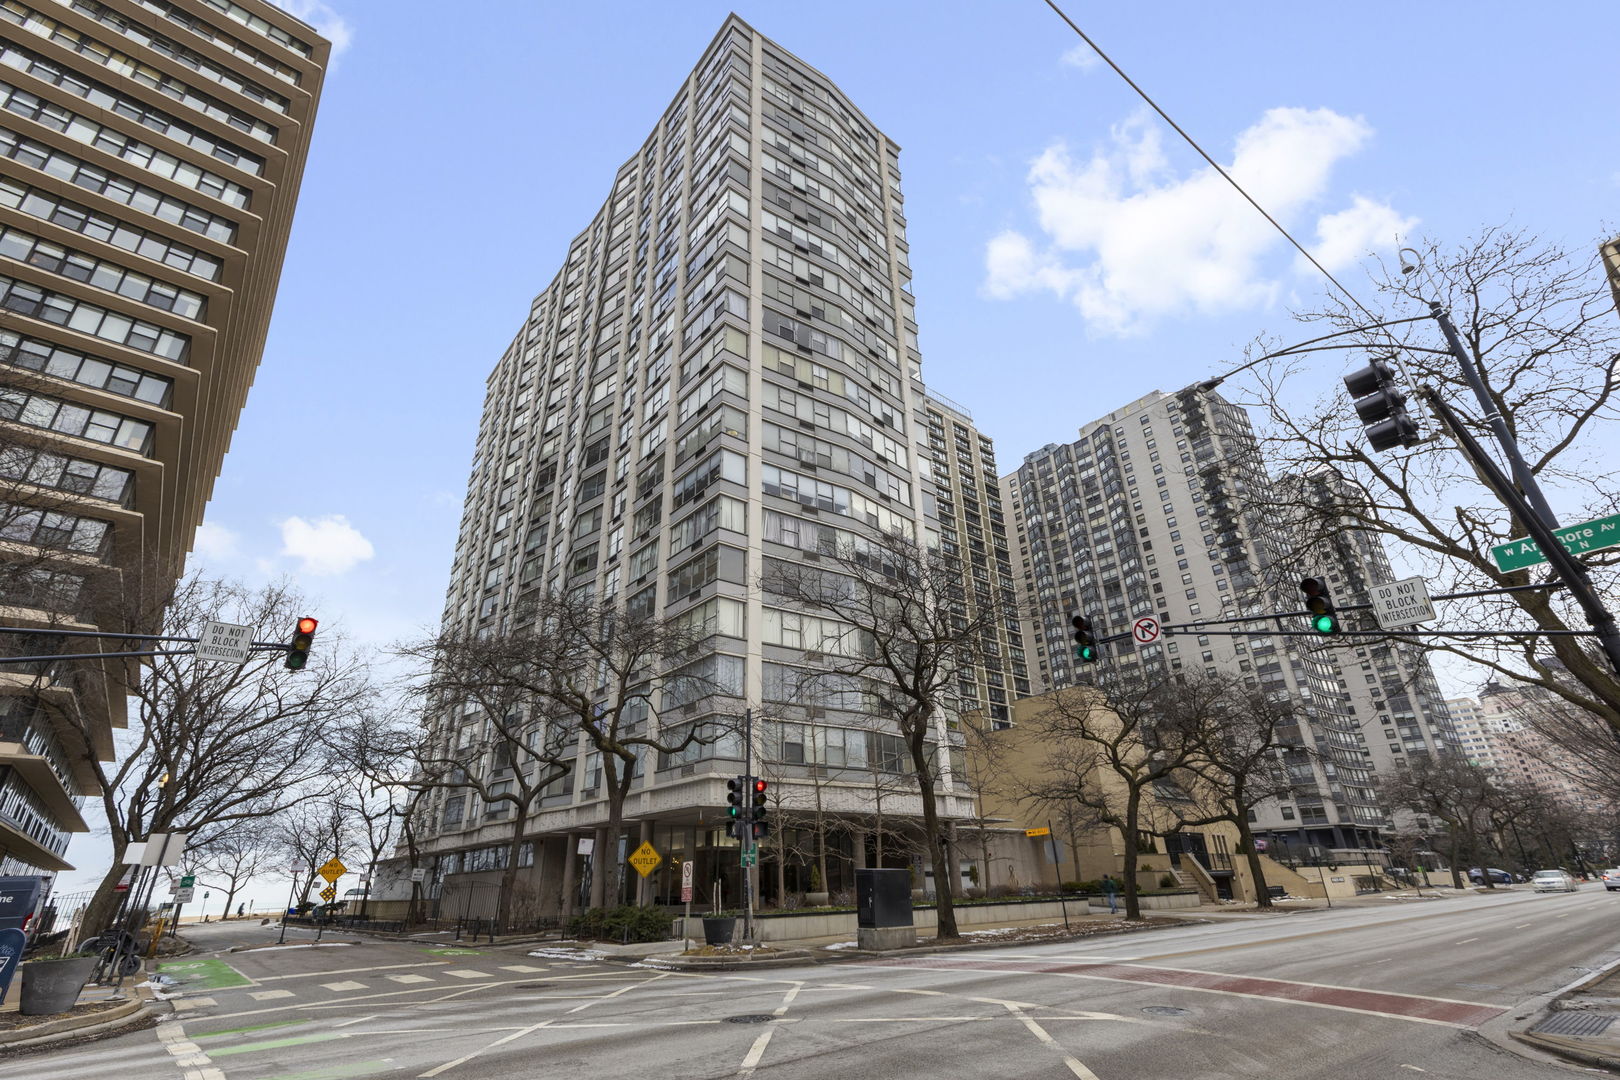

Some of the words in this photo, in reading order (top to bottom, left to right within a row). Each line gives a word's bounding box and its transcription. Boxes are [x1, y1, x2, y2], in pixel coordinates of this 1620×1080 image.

[1504, 547, 1514, 557] W
[1521, 528, 1594, 554] Armore
[1600, 522, 1616, 533] Av
[1580, 540, 1590, 549] N
[1378, 588, 1392, 599] DO
[1396, 582, 1416, 596] NOT
[1385, 595, 1418, 610] BLOCK
[1381, 604, 1432, 624] INTERSECTION
[212, 625, 224, 635] DO
[228, 626, 246, 638] NOT
[211, 634, 240, 647] BLOCK
[200, 645, 245, 659] INTERSECTION
[633, 857, 657, 865] OUTLET
